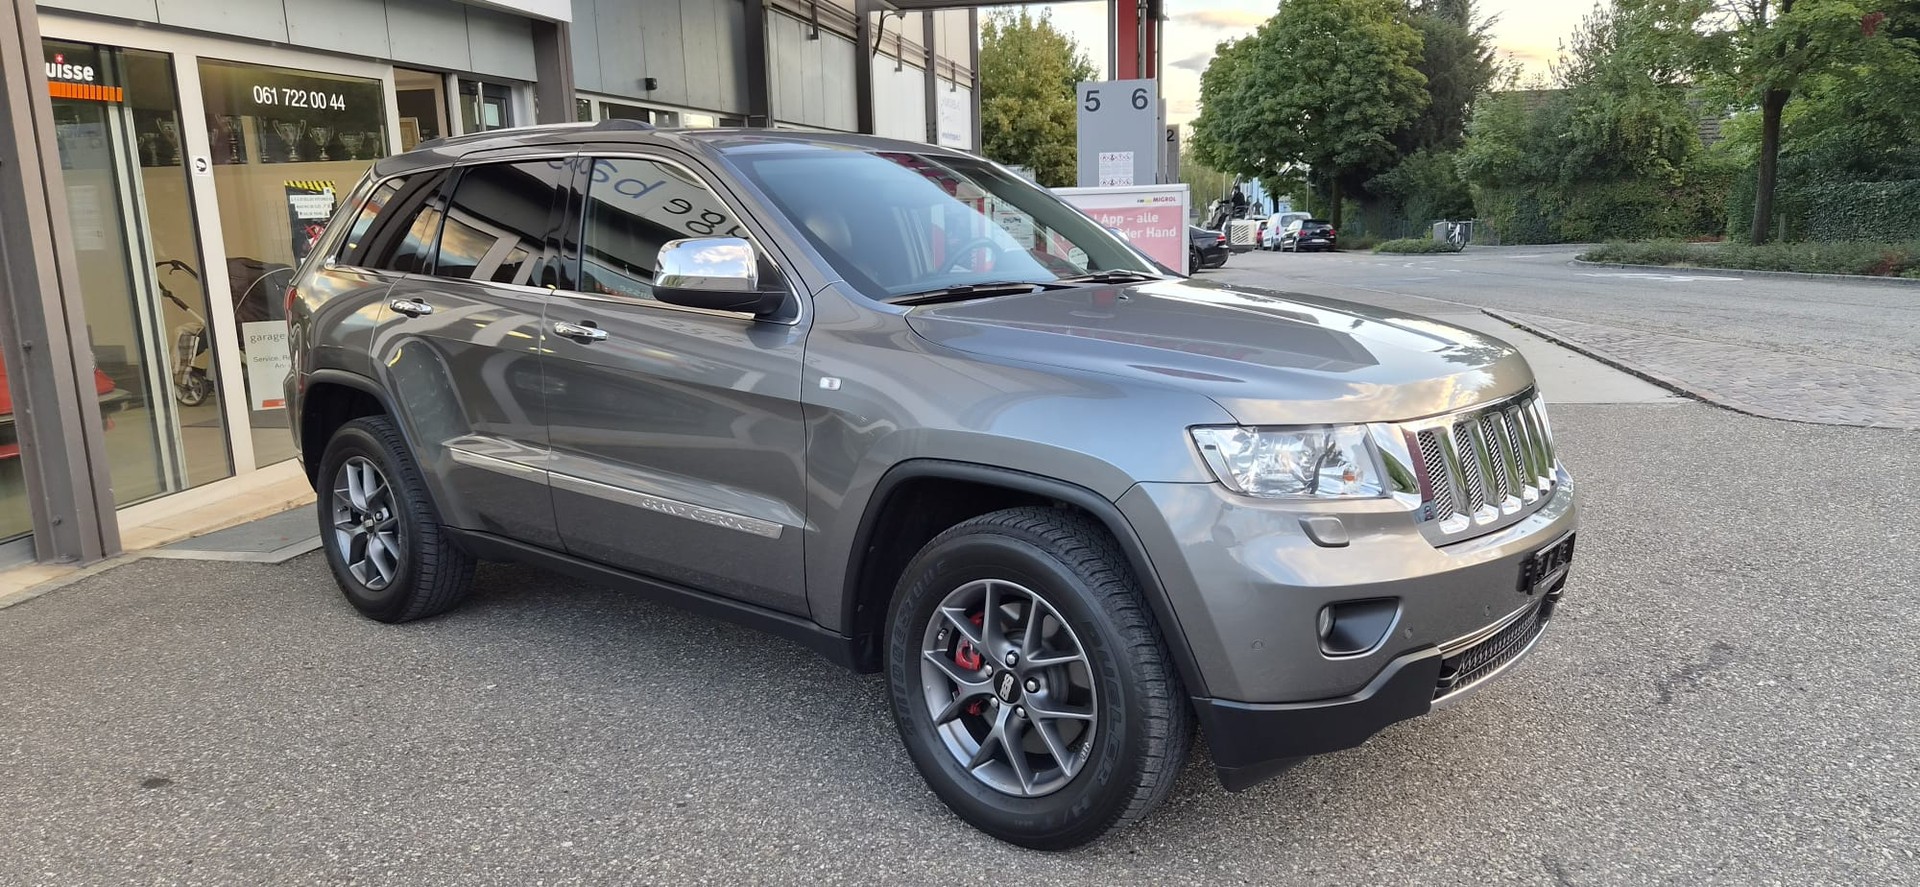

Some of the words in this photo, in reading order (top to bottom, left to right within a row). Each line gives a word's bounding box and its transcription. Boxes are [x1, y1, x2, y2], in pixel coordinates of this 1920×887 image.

[253, 85, 278, 105] 061
[282, 88, 308, 108] 722
[310, 91, 327, 109] 00
[329, 93, 346, 111] 44
[1084, 89, 1101, 112] 5
[1131, 87, 1148, 110] 6
[1166, 129, 1175, 142] 2
[1100, 213, 1124, 227] App
[1136, 212, 1159, 223] alle
[1146, 226, 1176, 238] Hand
[250, 333, 285, 344] garage
